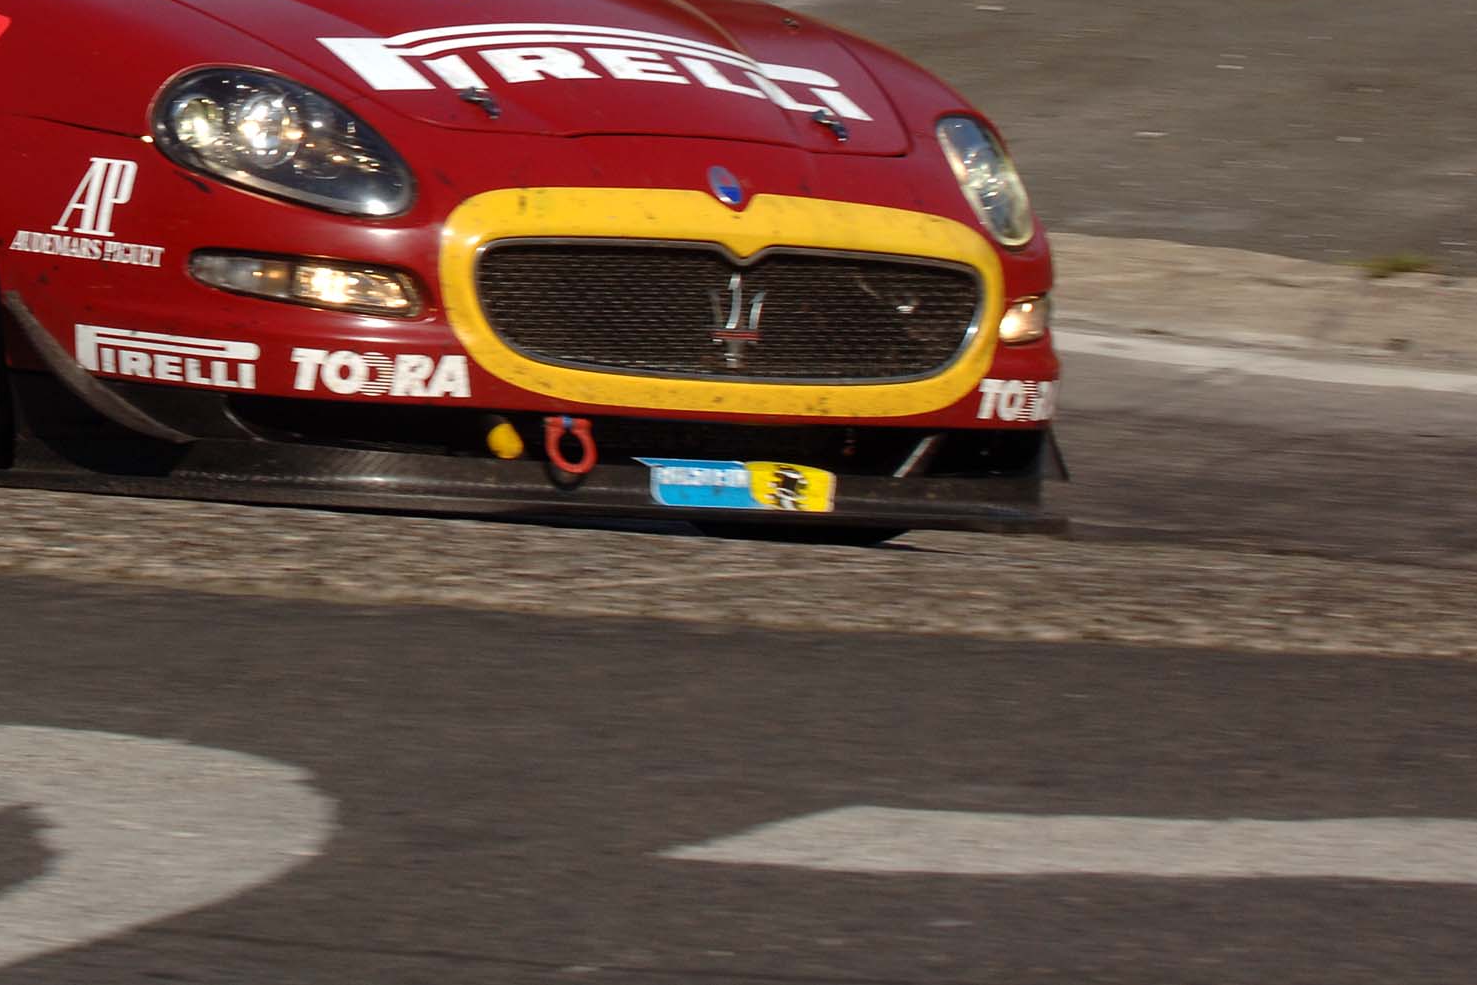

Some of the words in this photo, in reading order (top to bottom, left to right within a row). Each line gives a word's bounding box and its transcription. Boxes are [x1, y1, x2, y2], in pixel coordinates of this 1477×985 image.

[316, 22, 873, 121] PIRELLI
[51, 157, 138, 236] AP
[75, 323, 260, 390] PIRELLI
[975, 378, 1060, 422] TOOR
